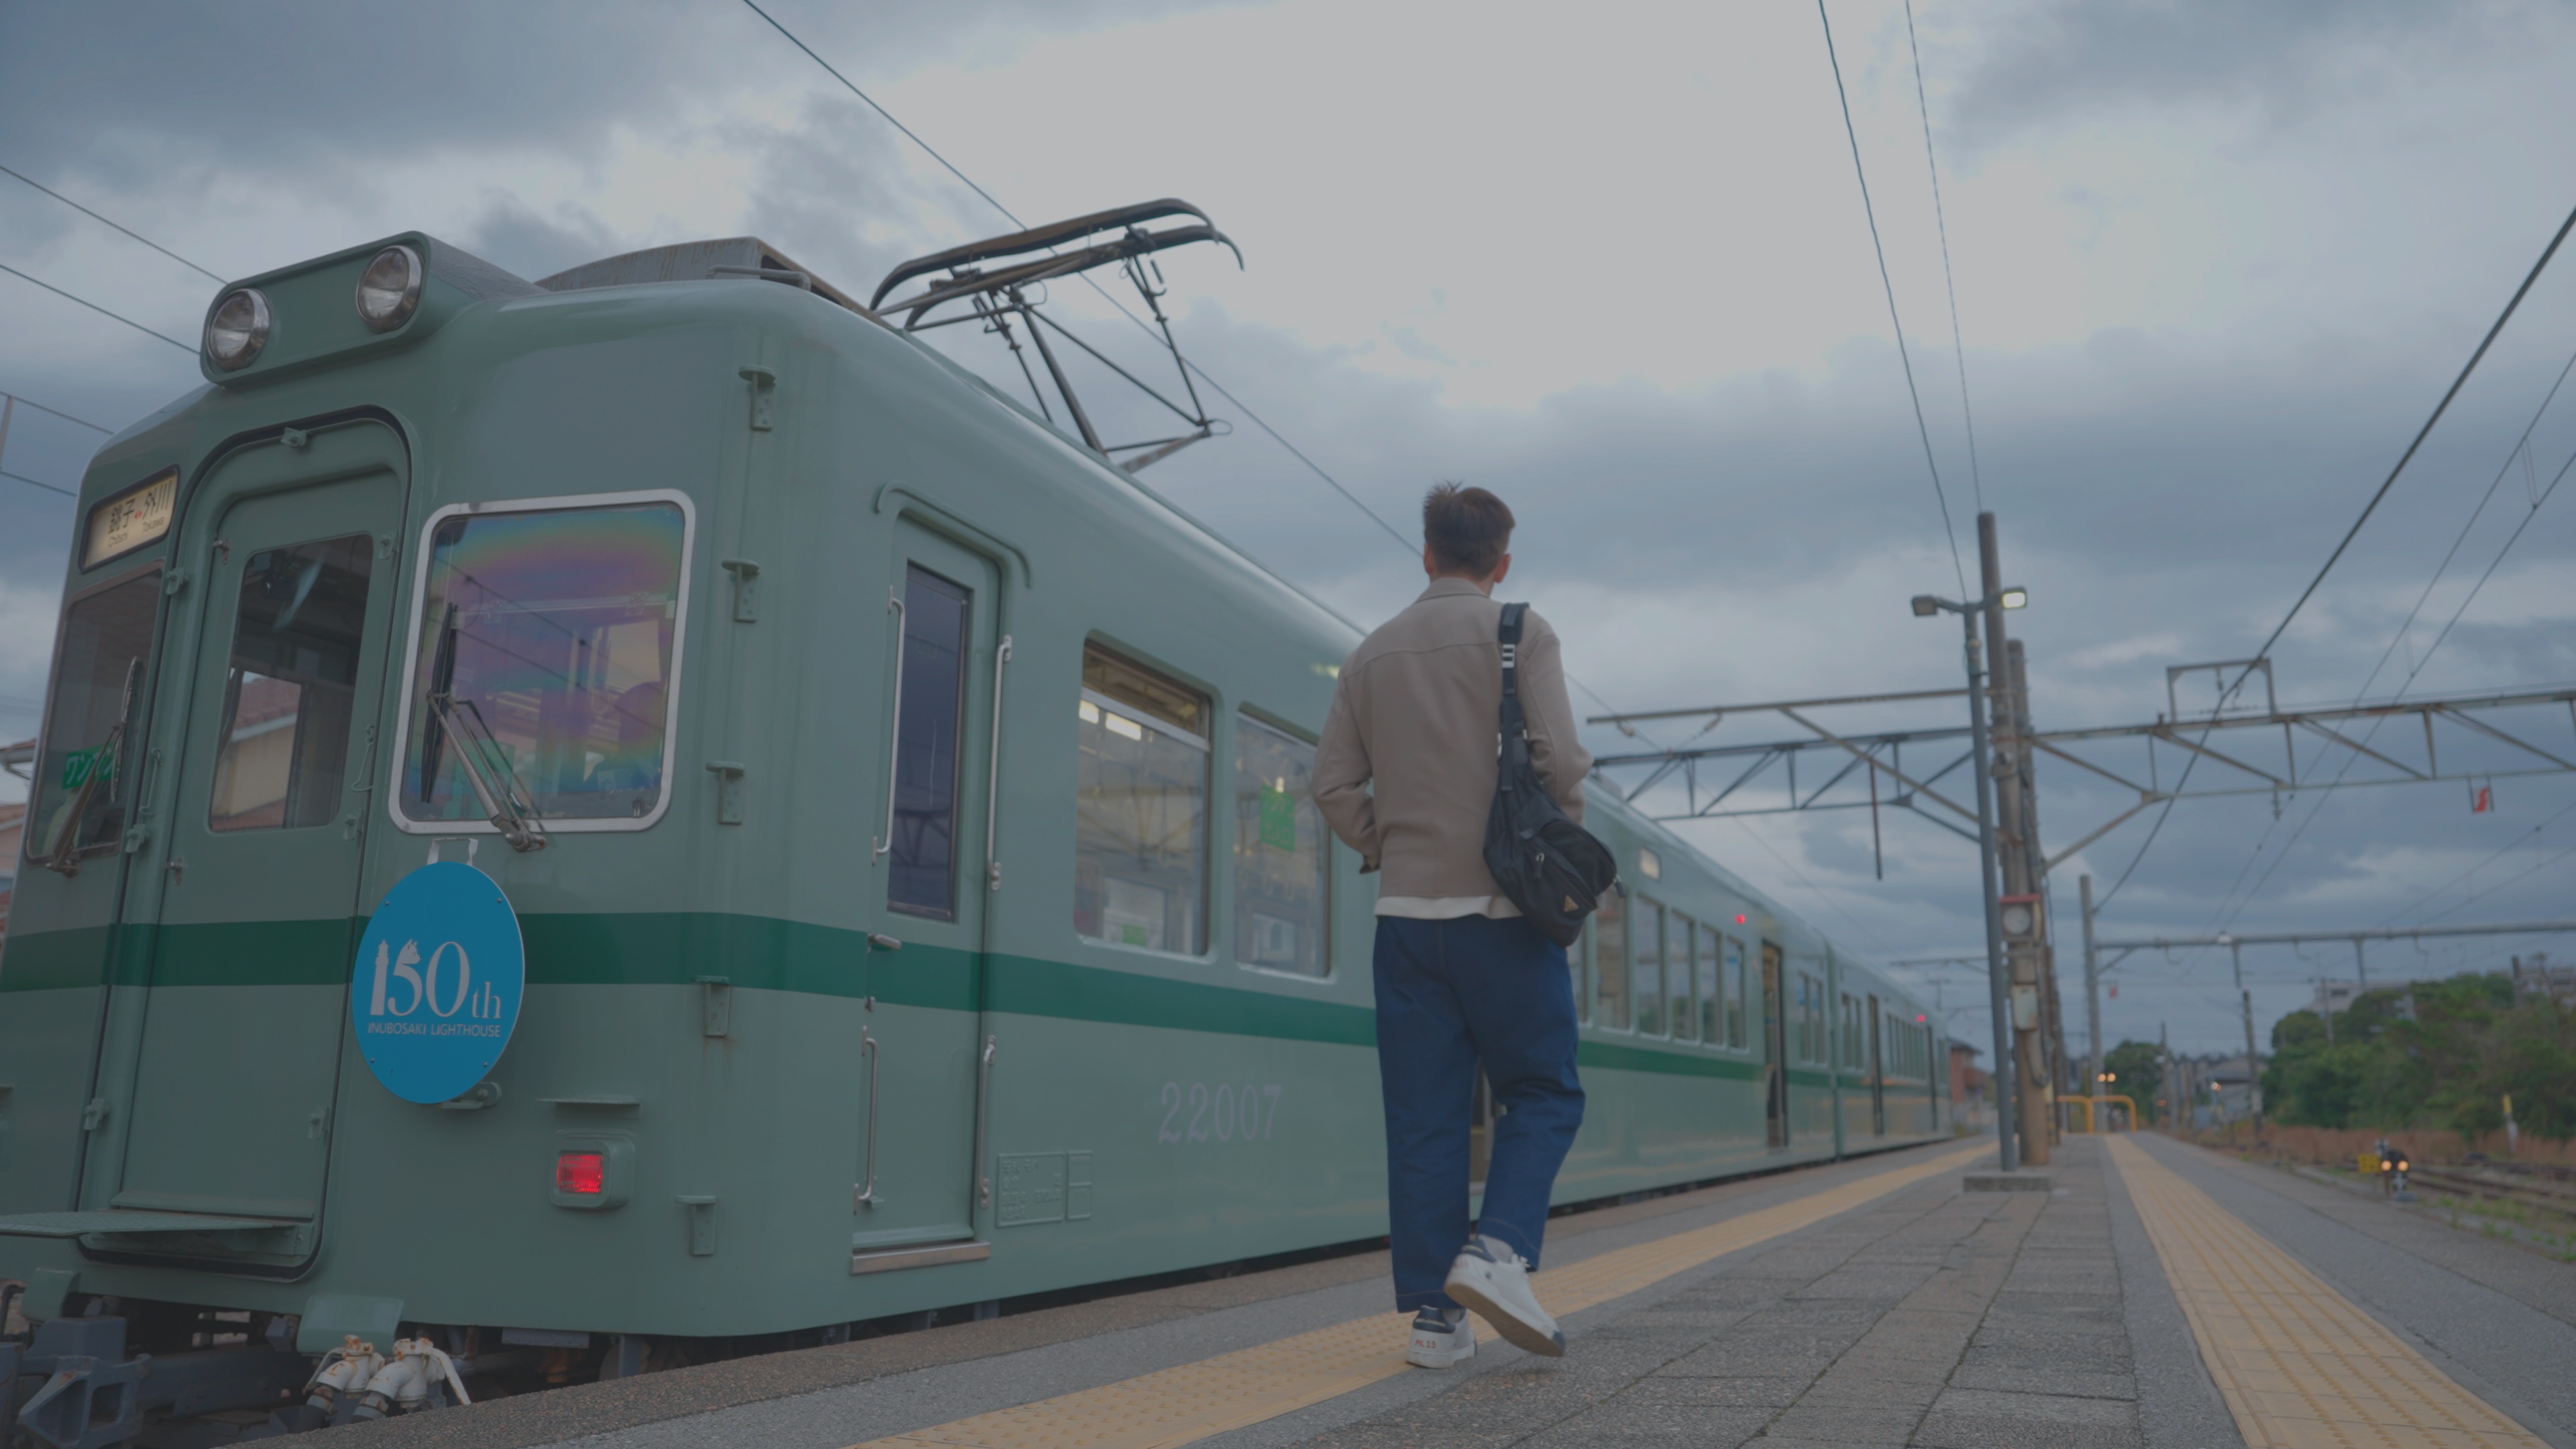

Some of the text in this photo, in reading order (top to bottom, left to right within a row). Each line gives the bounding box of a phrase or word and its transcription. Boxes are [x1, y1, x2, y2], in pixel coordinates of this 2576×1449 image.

[142, 480, 172, 519] 外川
[368, 1023, 501, 1037] INUBOSAKI LIGHTHOUSE
[1158, 1081, 1283, 1141] 22007
